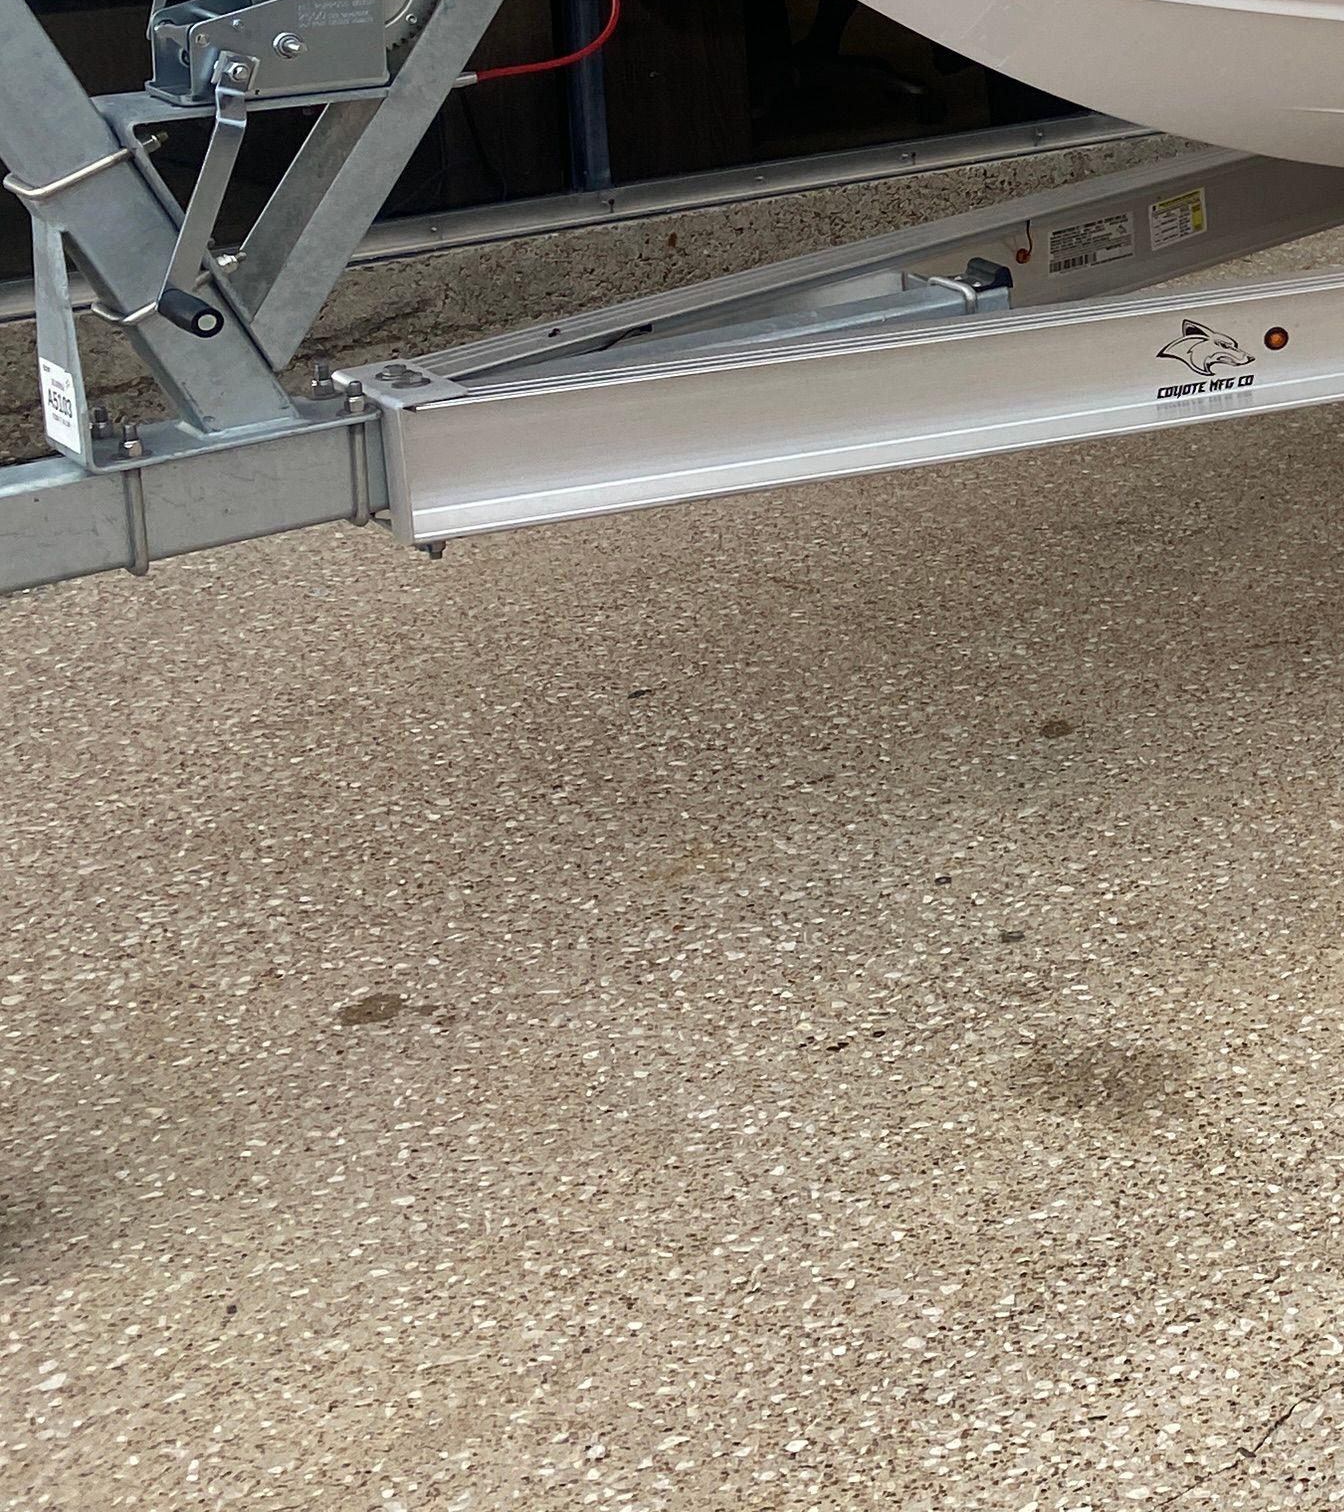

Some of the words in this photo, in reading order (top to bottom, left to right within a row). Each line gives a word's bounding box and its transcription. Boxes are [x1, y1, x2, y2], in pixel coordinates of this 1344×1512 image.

[1157, 381, 1207, 399] COYOTE
[1210, 377, 1237, 392] MFG
[1238, 375, 1254, 388] CO
